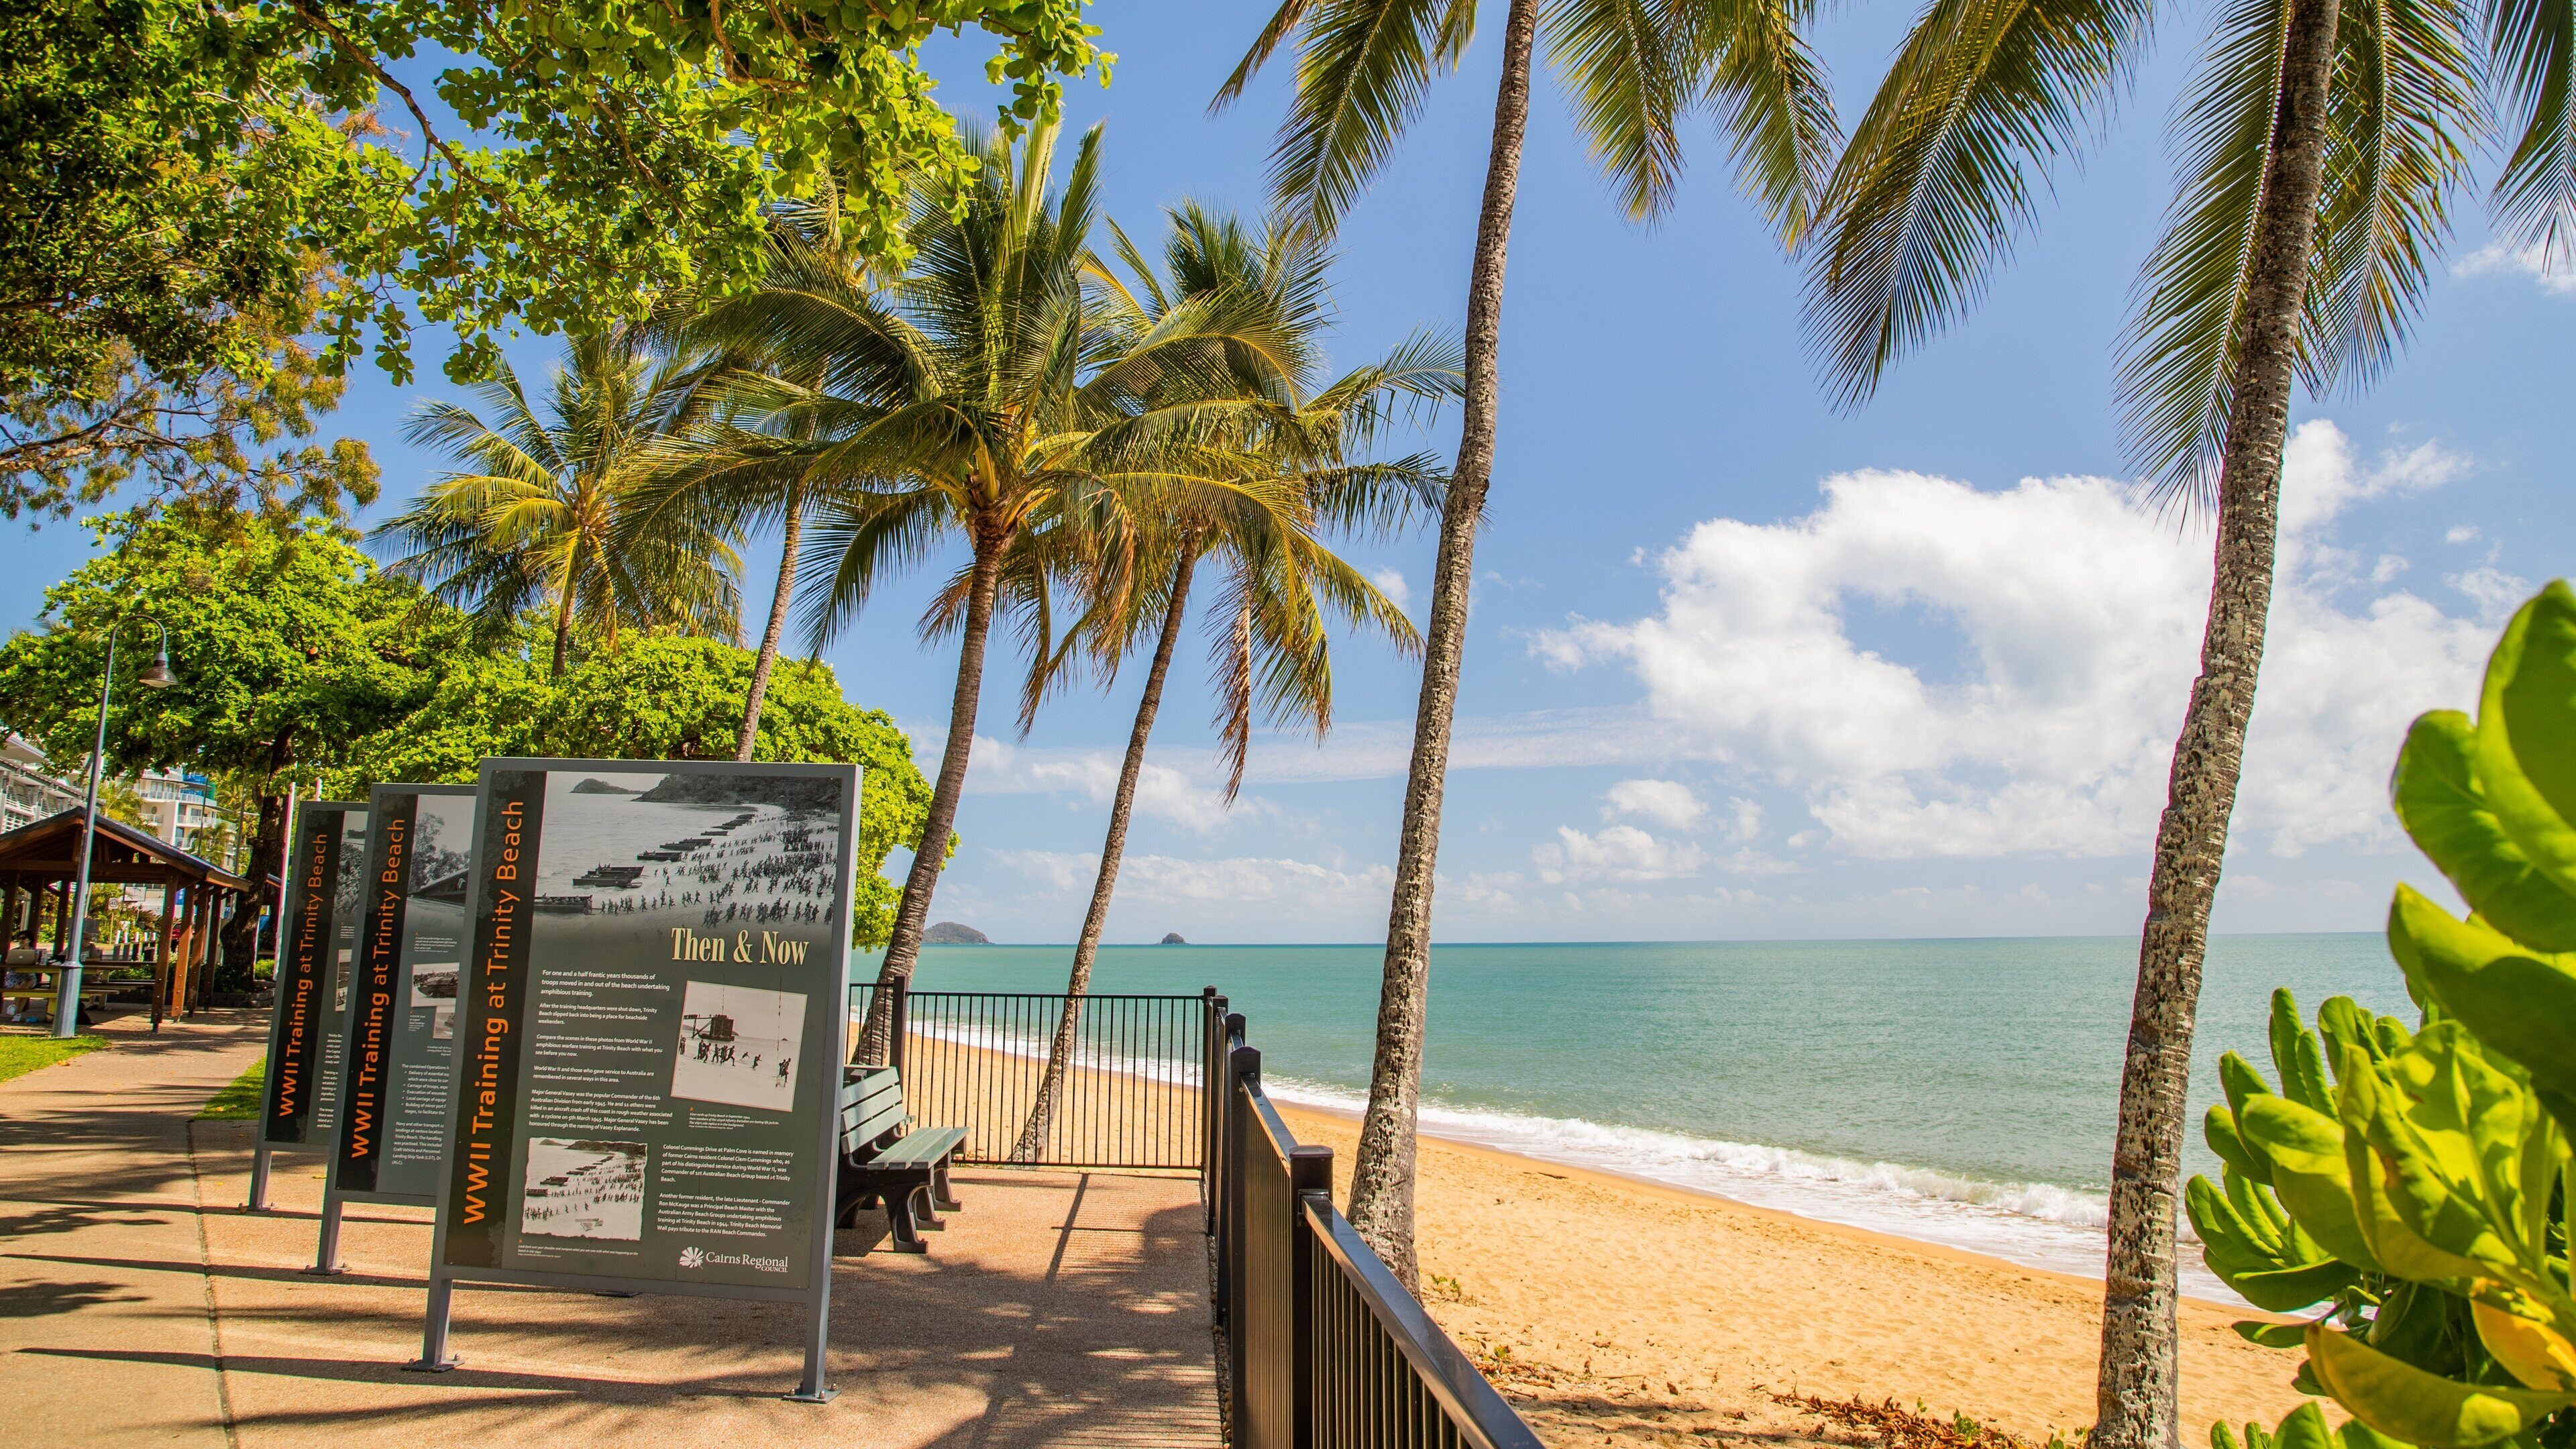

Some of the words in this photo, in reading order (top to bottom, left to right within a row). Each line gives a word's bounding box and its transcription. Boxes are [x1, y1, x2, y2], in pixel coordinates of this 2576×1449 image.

[308, 834, 327, 888] Beach
[383, 819, 405, 883] Beach
[496, 802, 524, 881] Beach
[300, 894, 323, 952] Trinity
[374, 890, 401, 959] Trinity
[487, 890, 521, 976] Trinity
[671, 928, 725, 961] Then
[733, 930, 753, 963] &
[759, 931, 810, 965] Now
[301, 955, 312, 973] at
[374, 965, 389, 986] at
[487, 983, 506, 1009] at
[286, 979, 314, 1058] Training
[360, 993, 390, 1087] Training
[280, 1062, 299, 1118] WWII
[472, 1018, 509, 1134] Training
[352, 1092, 374, 1159] WWII
[464, 1142, 492, 1224] WWII
[706, 1252, 740, 1265] Cairns
[742, 1254, 788, 1269] Regional
